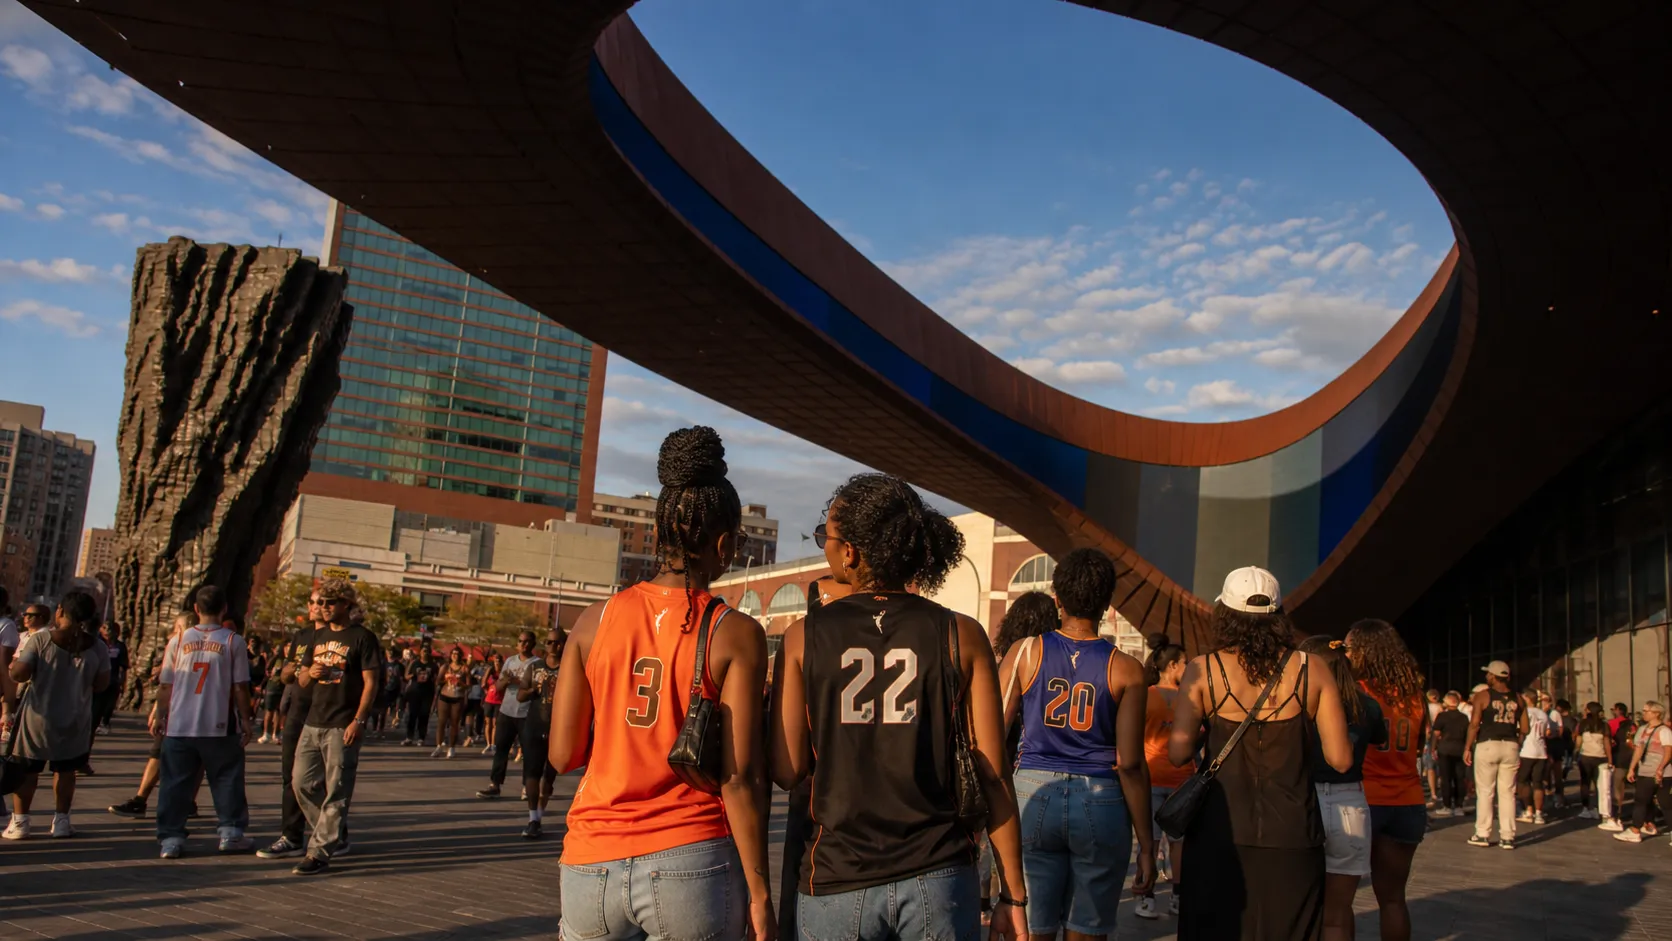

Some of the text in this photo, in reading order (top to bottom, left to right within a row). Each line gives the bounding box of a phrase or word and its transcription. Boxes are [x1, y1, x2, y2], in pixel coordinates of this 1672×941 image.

[192, 661, 210, 695] 7
[625, 656, 664, 729] 3
[841, 647, 918, 724] 22
[1044, 677, 1096, 732] 20
